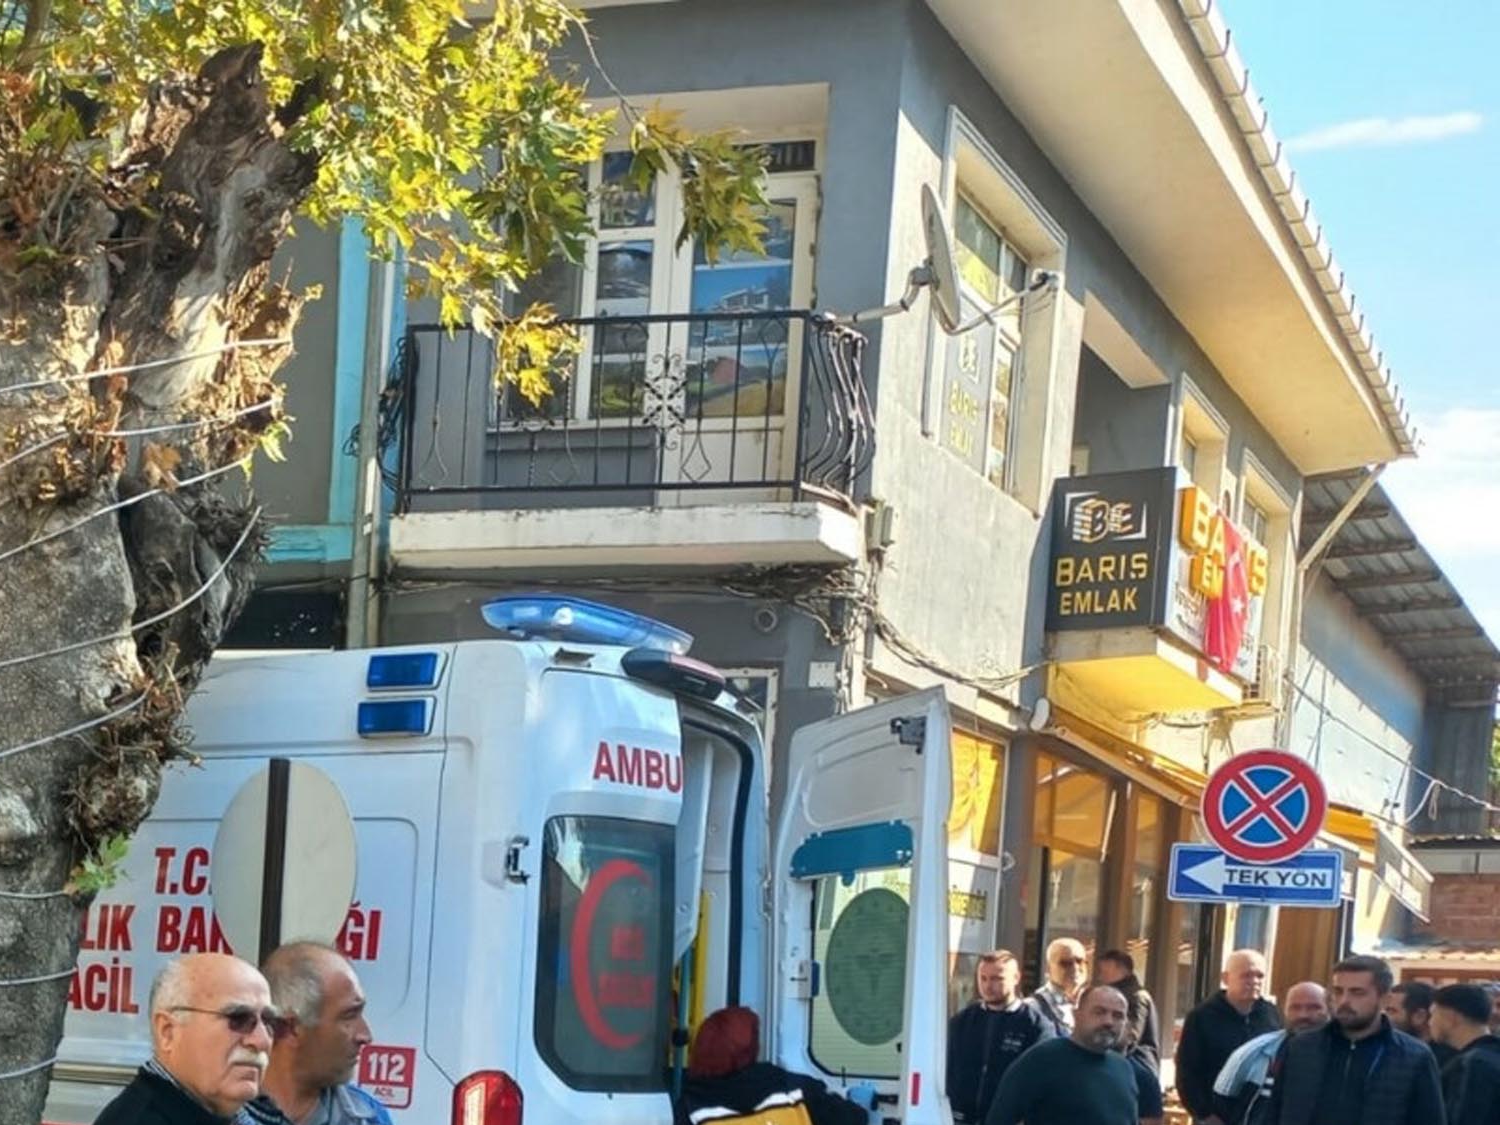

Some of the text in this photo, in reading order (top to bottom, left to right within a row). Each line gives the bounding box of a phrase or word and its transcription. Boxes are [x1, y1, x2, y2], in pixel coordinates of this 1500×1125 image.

[1059, 587, 1138, 615] EMLAK
[593, 741, 682, 793] AMBU
[1225, 868, 1269, 886] TEK
[368, 1052, 406, 1083] 112
